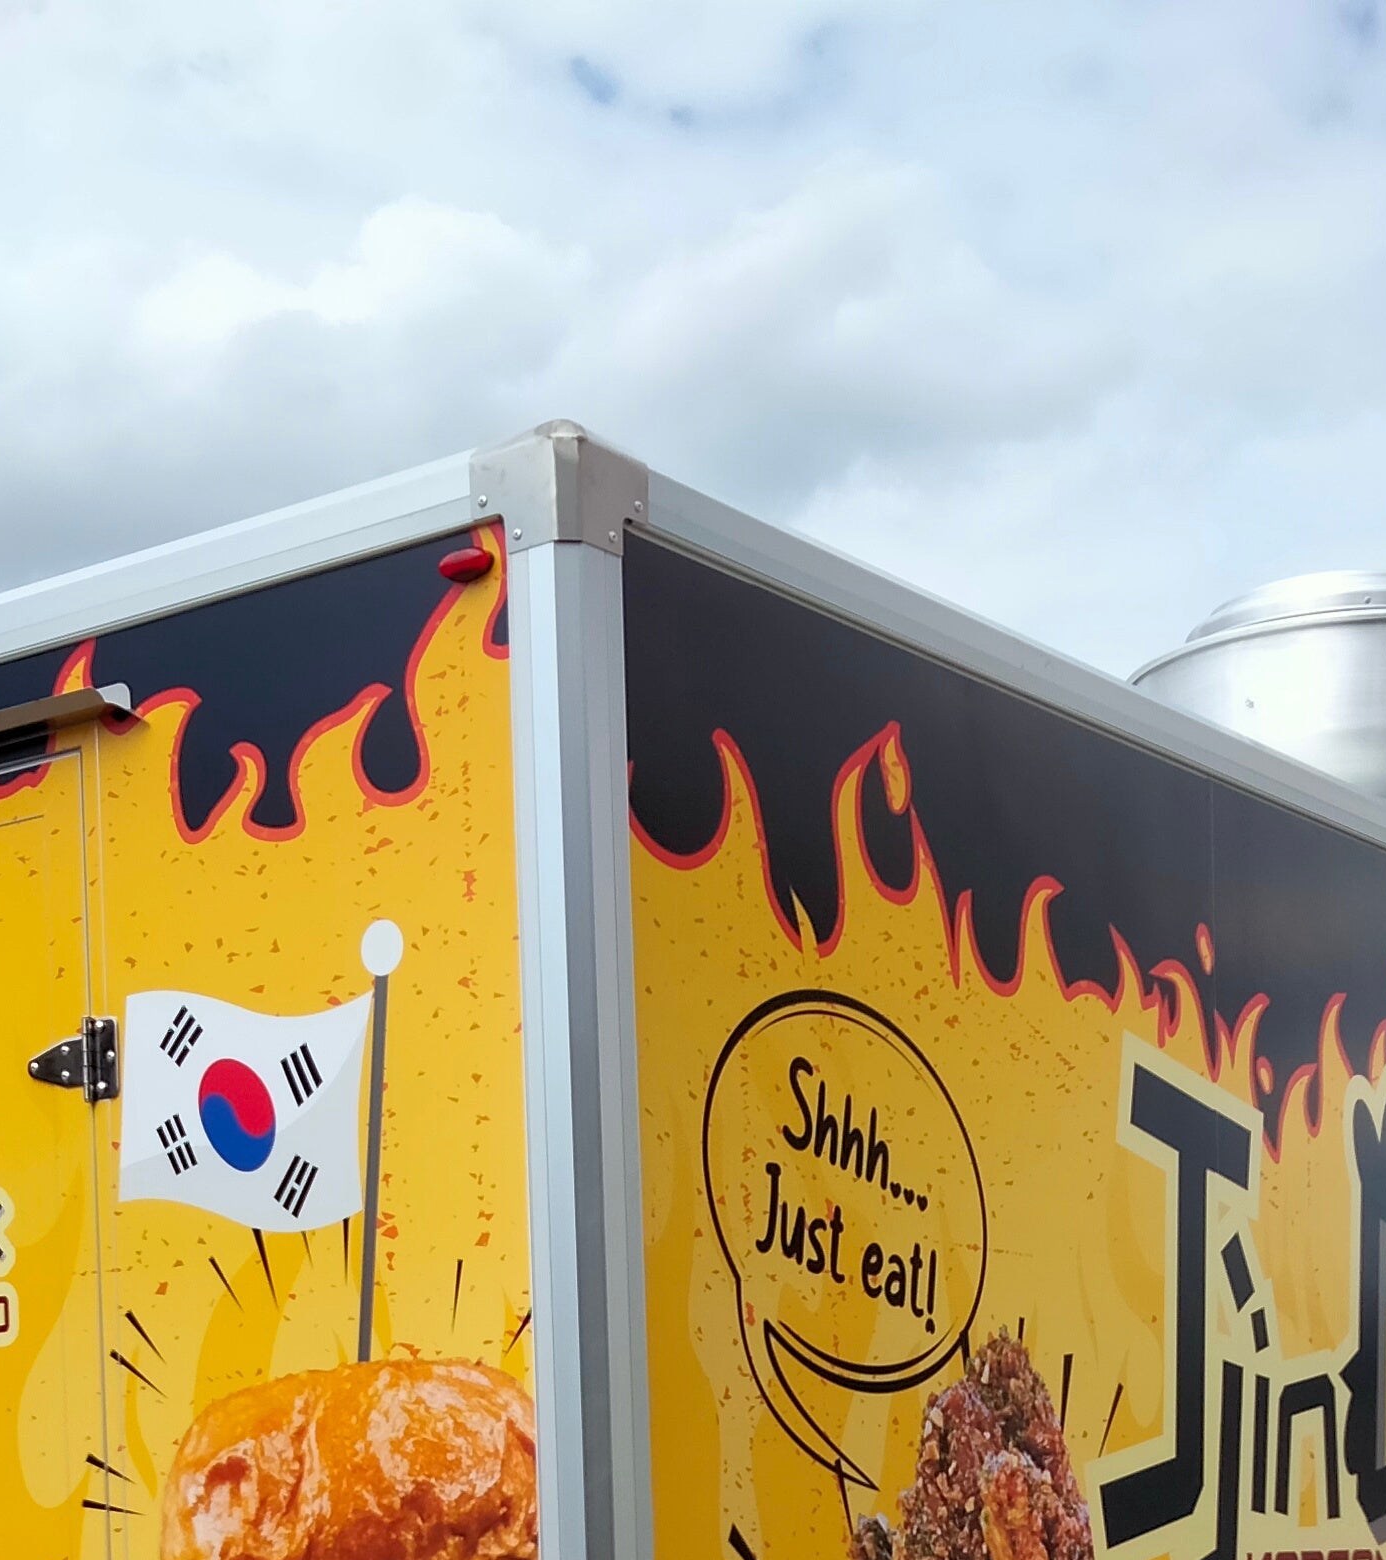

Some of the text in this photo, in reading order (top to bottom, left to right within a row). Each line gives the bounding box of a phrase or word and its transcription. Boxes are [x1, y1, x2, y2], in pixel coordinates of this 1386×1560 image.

[782, 1056, 929, 1212] Shhh...
[755, 1162, 937, 1335] Just eat!
